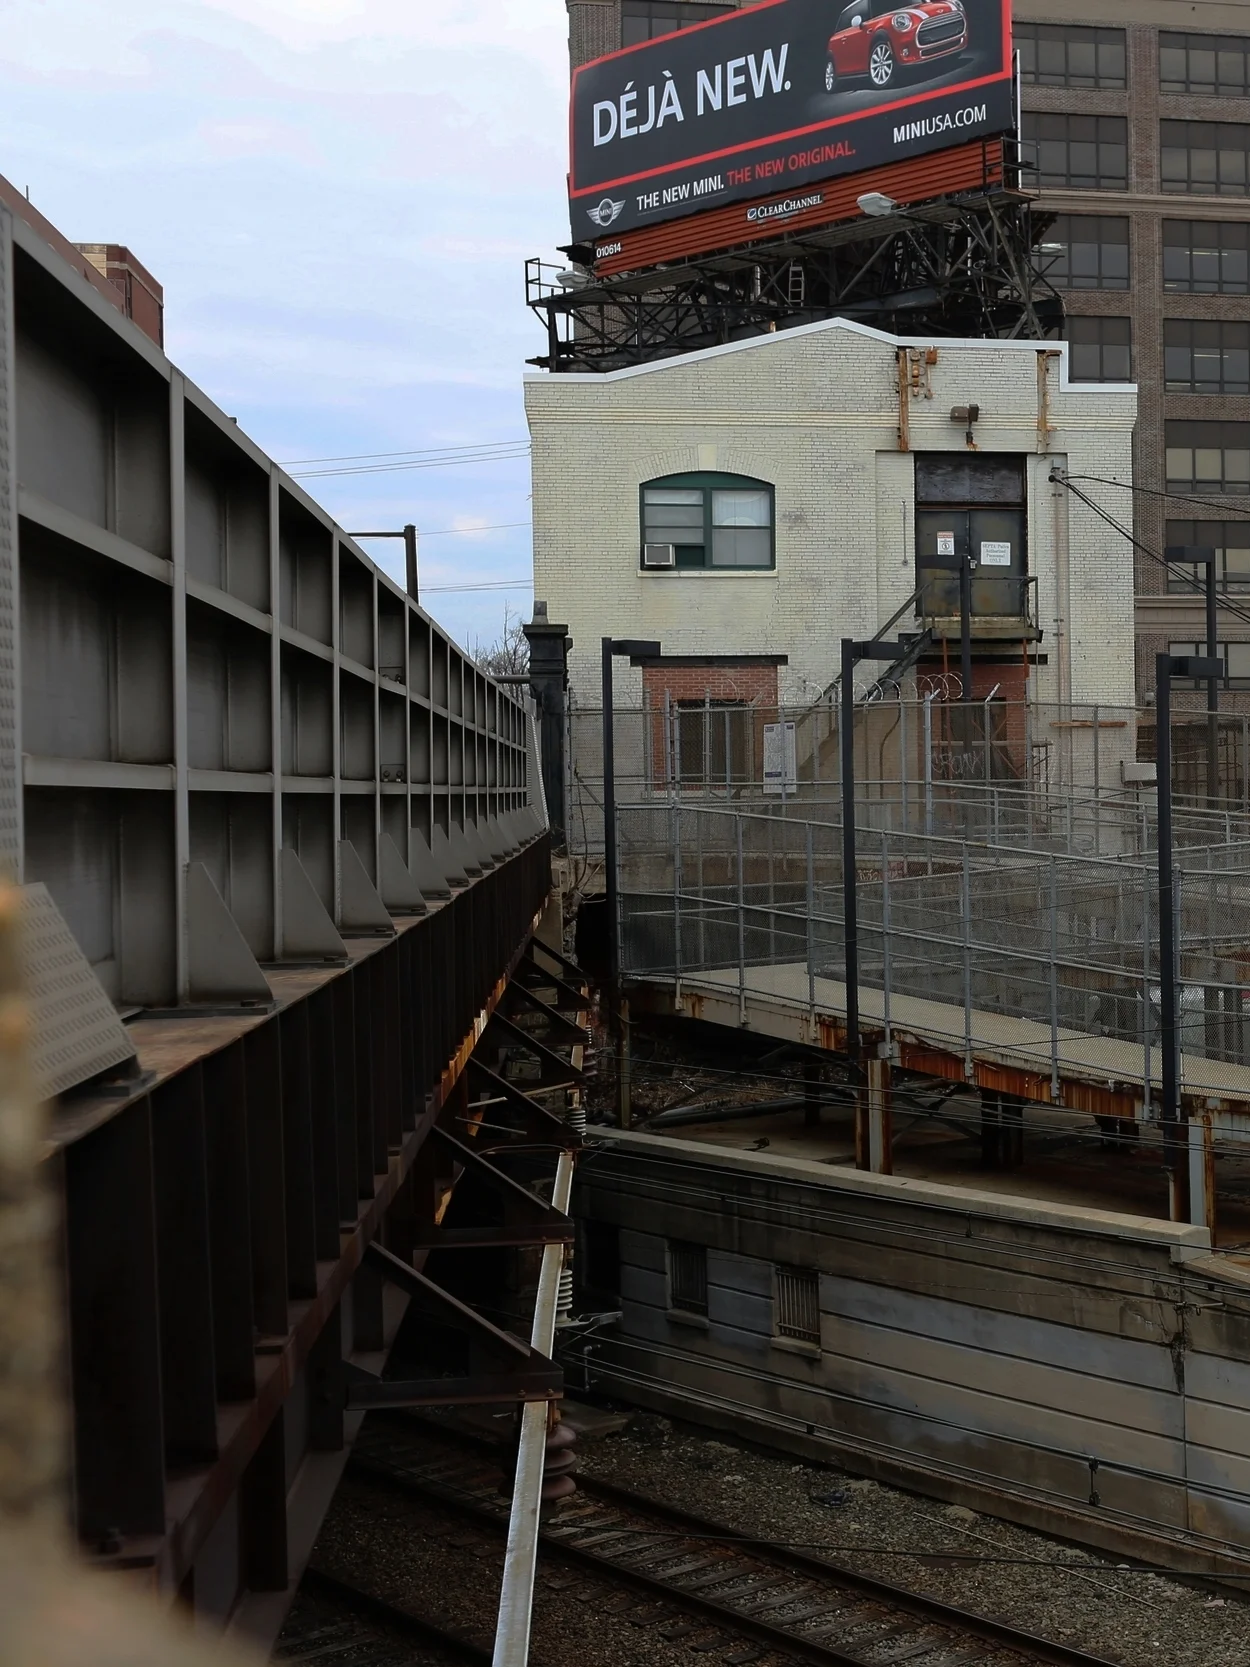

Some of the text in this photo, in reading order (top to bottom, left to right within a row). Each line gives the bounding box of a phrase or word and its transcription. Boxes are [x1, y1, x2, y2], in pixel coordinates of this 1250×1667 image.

[593, 43, 791, 147] DÉJÀ NEW.
[893, 104, 987, 144] MINIUSA.COM
[636, 140, 856, 211] THE NEW MINI. THE NEW ORIGINAL.
[599, 208, 612, 217] MINI
[596, 242, 621, 258] 010614
